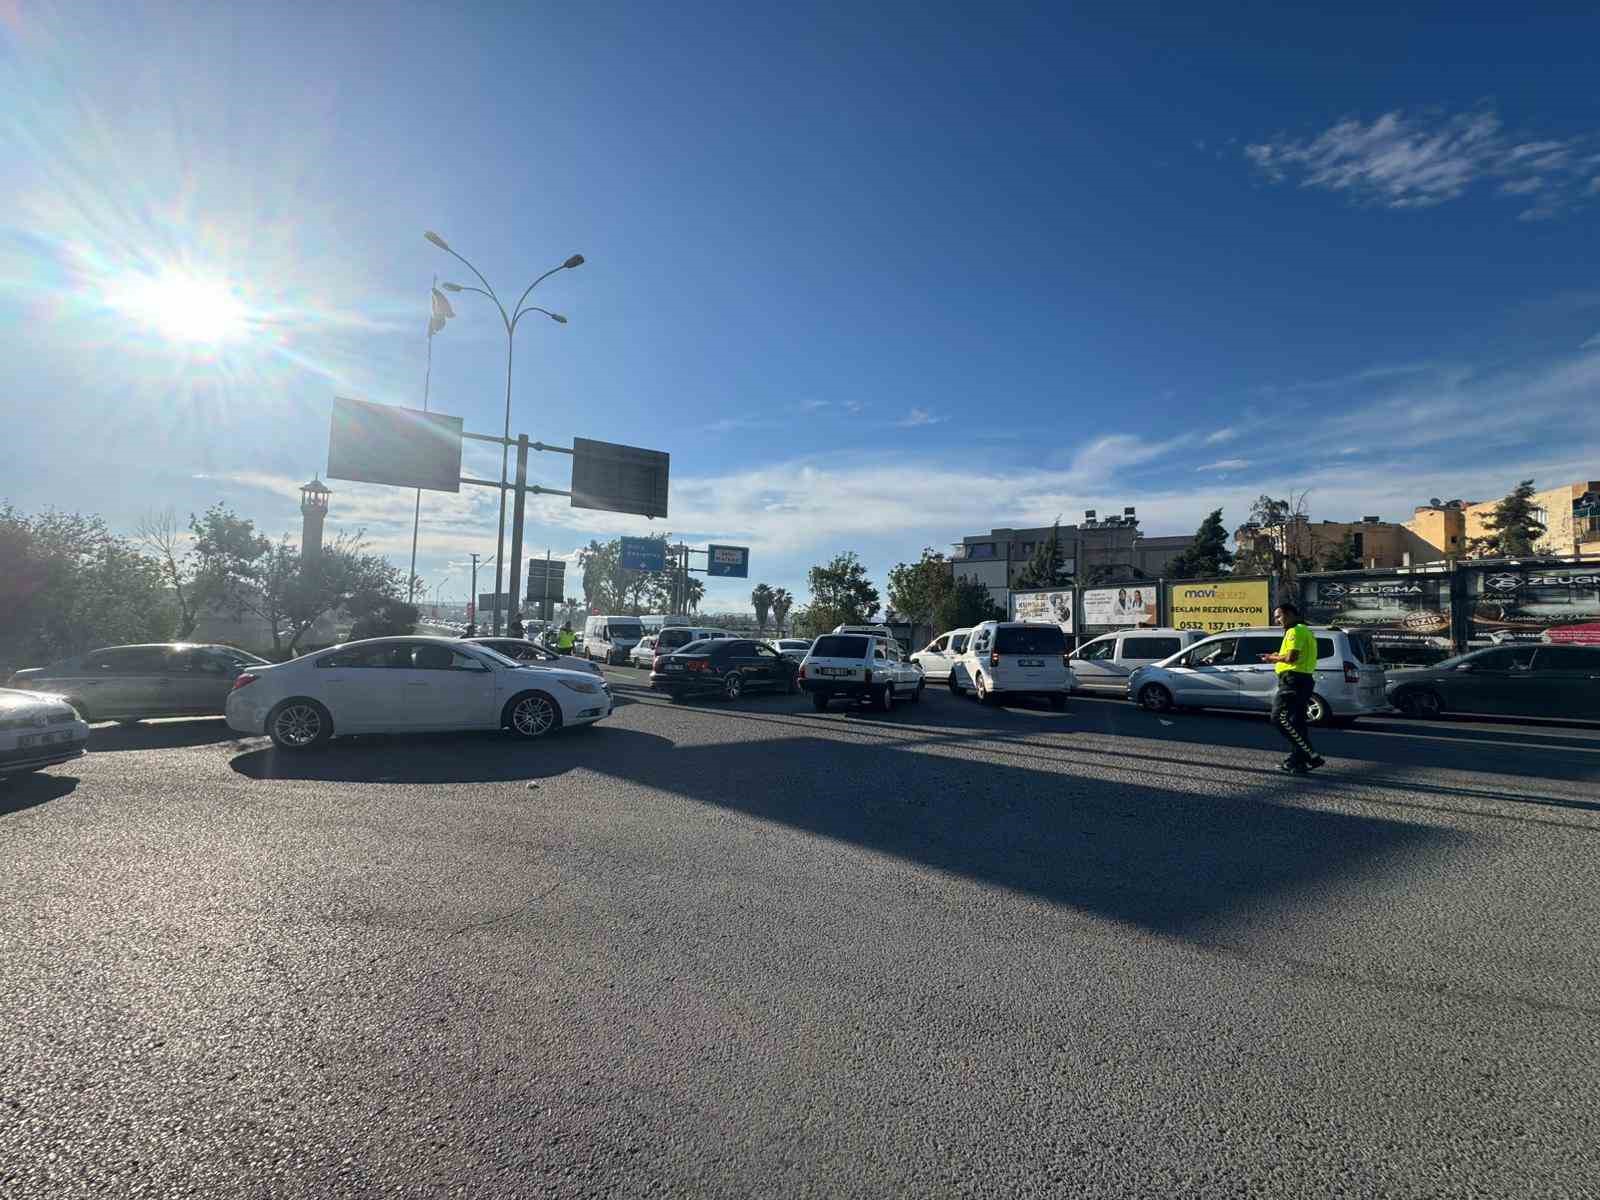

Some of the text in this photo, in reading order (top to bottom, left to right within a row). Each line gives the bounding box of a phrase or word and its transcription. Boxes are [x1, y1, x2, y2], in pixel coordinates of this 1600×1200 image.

[1184, 585, 1218, 599] mavi
[1349, 585, 1423, 594] ZEUGMA
[1202, 606, 1263, 614] REZERVASYON
[1179, 621, 1204, 630] 0532
[1208, 622, 1223, 631] 137
